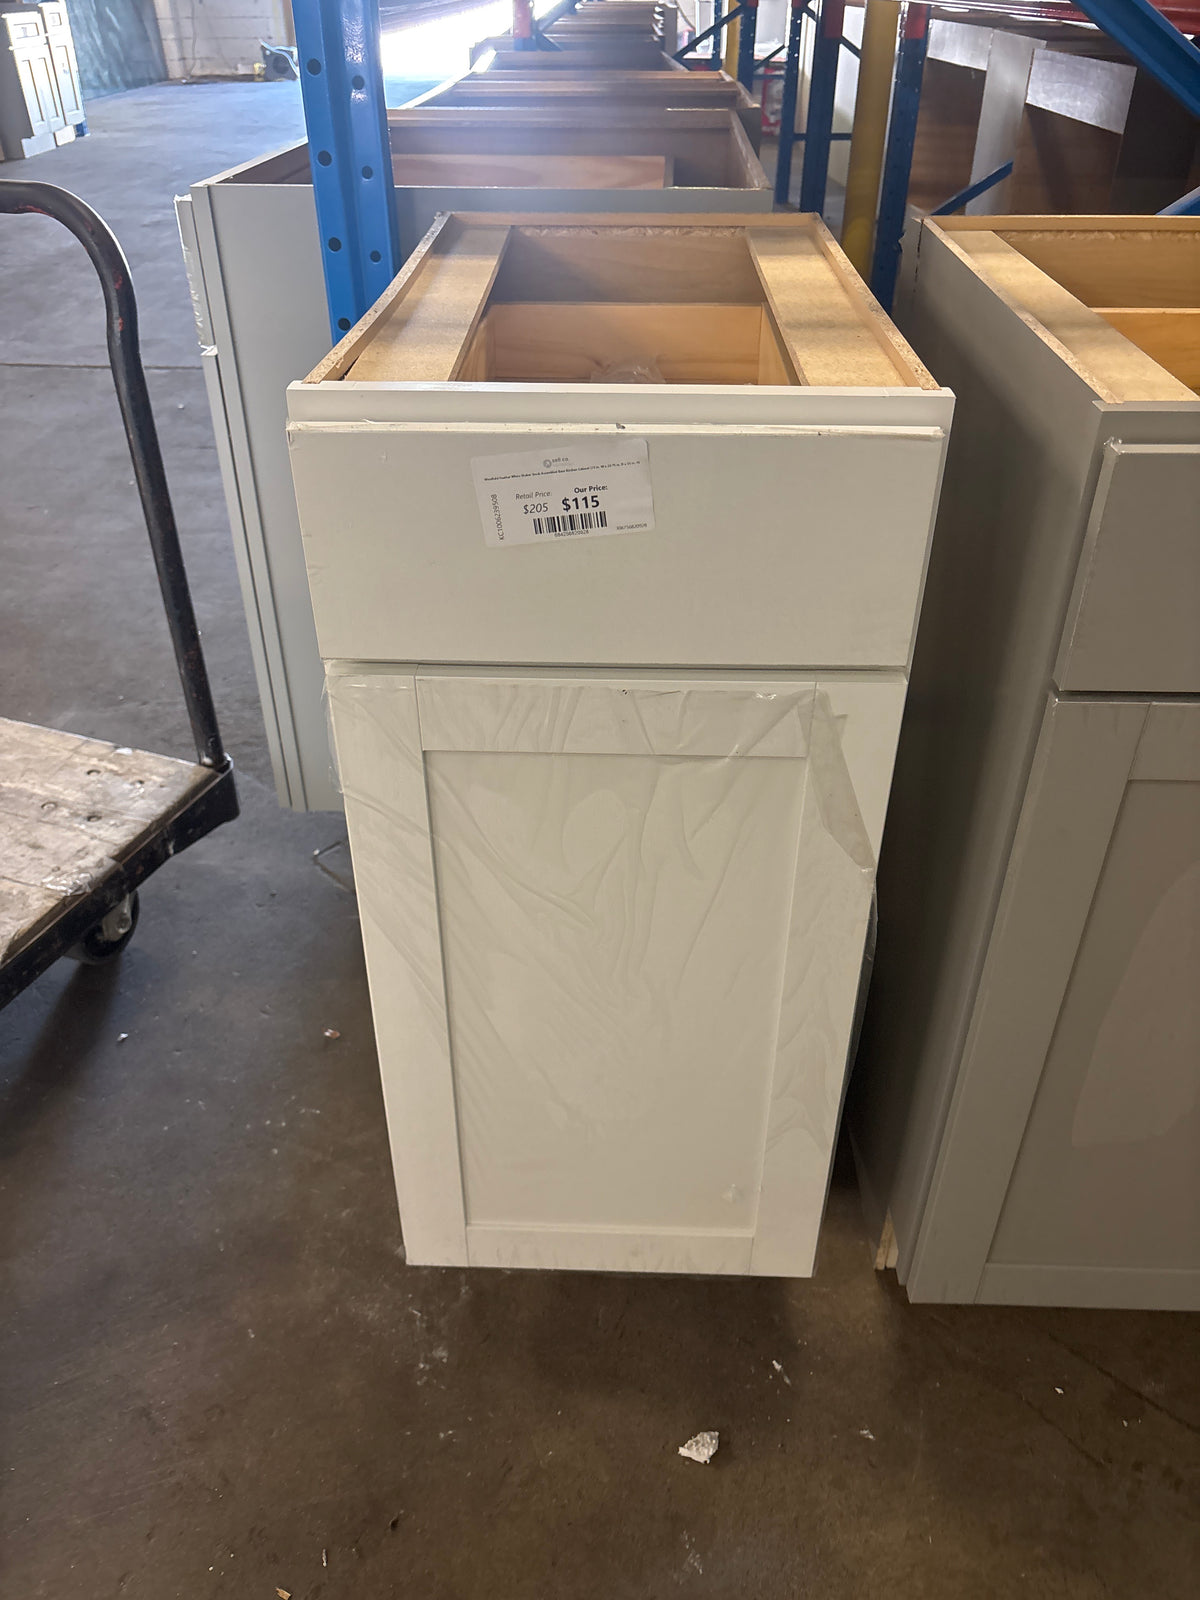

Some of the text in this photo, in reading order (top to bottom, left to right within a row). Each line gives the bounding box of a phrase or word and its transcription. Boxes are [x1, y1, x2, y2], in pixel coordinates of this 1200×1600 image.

[588, 484, 608, 492] Price:
[515, 492, 534, 500] Retail
[561, 494, 600, 512] $115
[523, 502, 549, 515] $205
